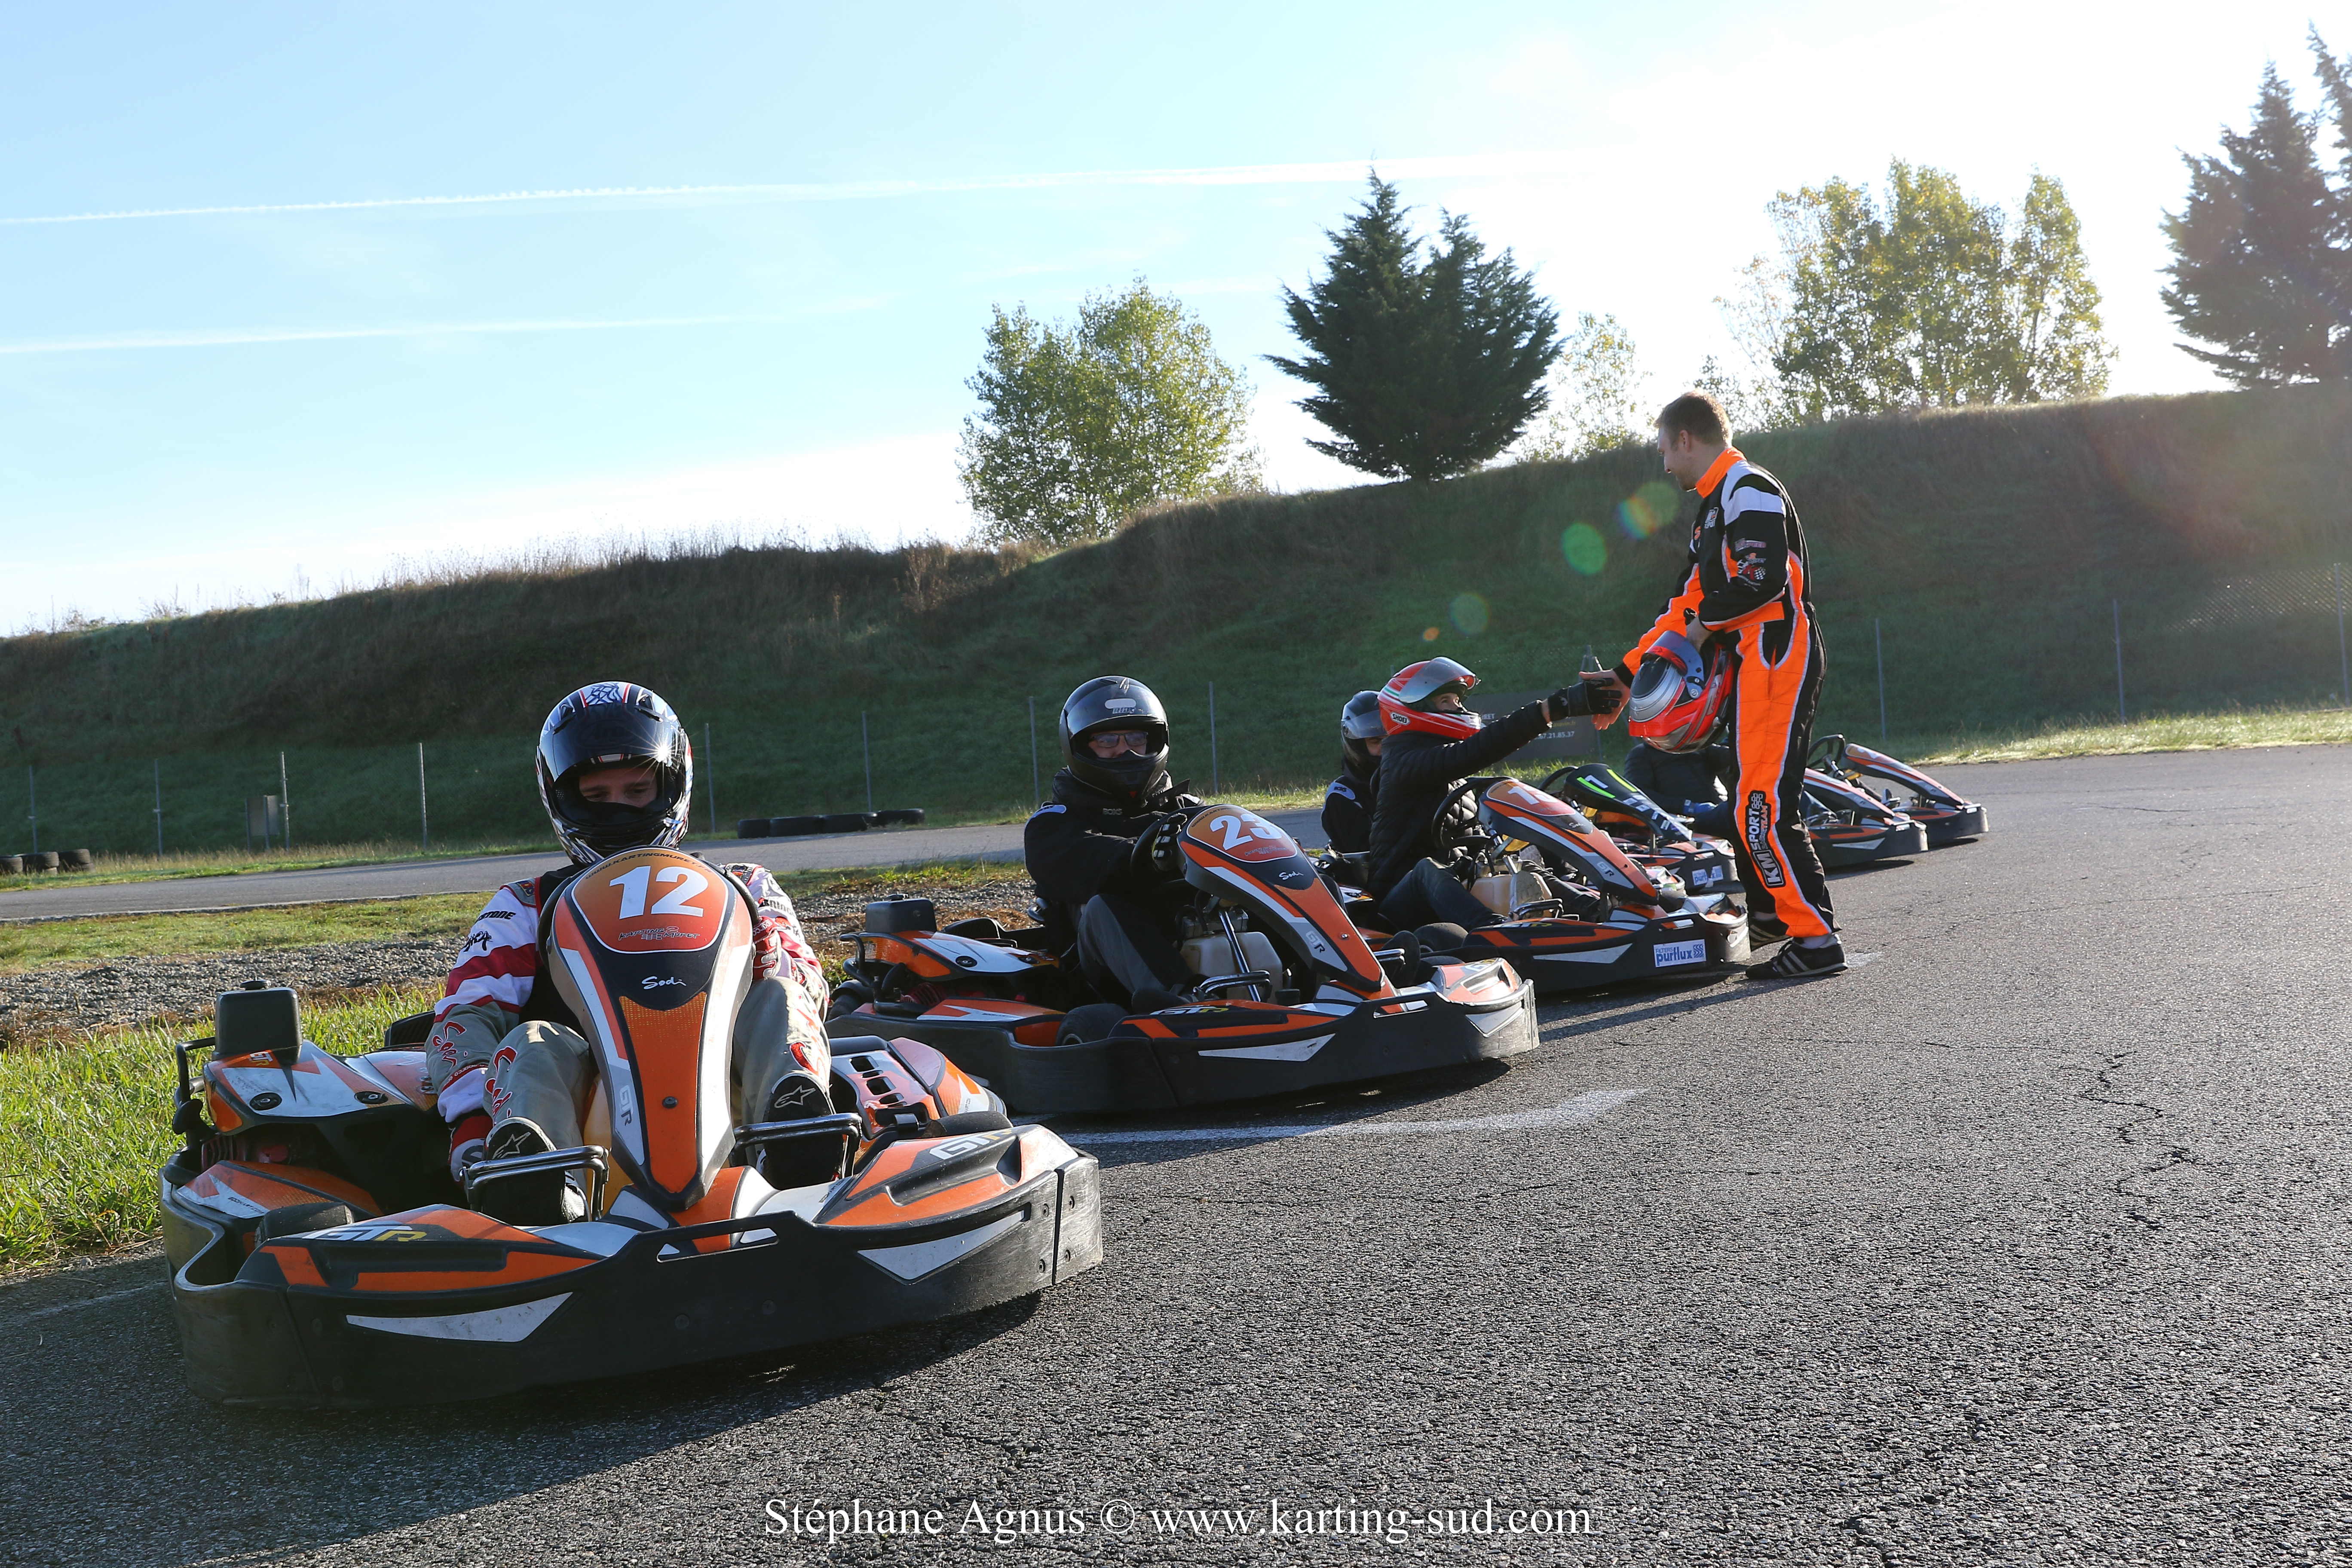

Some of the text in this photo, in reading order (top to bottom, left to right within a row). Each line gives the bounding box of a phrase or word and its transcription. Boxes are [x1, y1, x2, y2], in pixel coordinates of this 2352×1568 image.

[1393, 714, 1407, 723] SHOEI
[1210, 814, 1283, 851] 23
[1749, 808, 1762, 851] SPORT
[1756, 853, 1781, 883] KM
[609, 865, 709, 920] 12
[619, 928, 665, 941] KARTING
[1305, 931, 1326, 953] GTR
[1656, 946, 1693, 966] purflux
[1149, 1005, 1229, 1015] GTR
[248, 1051, 273, 1067] GTR
[619, 1084, 633, 1127] GTR
[303, 1225, 427, 1242] GTR
